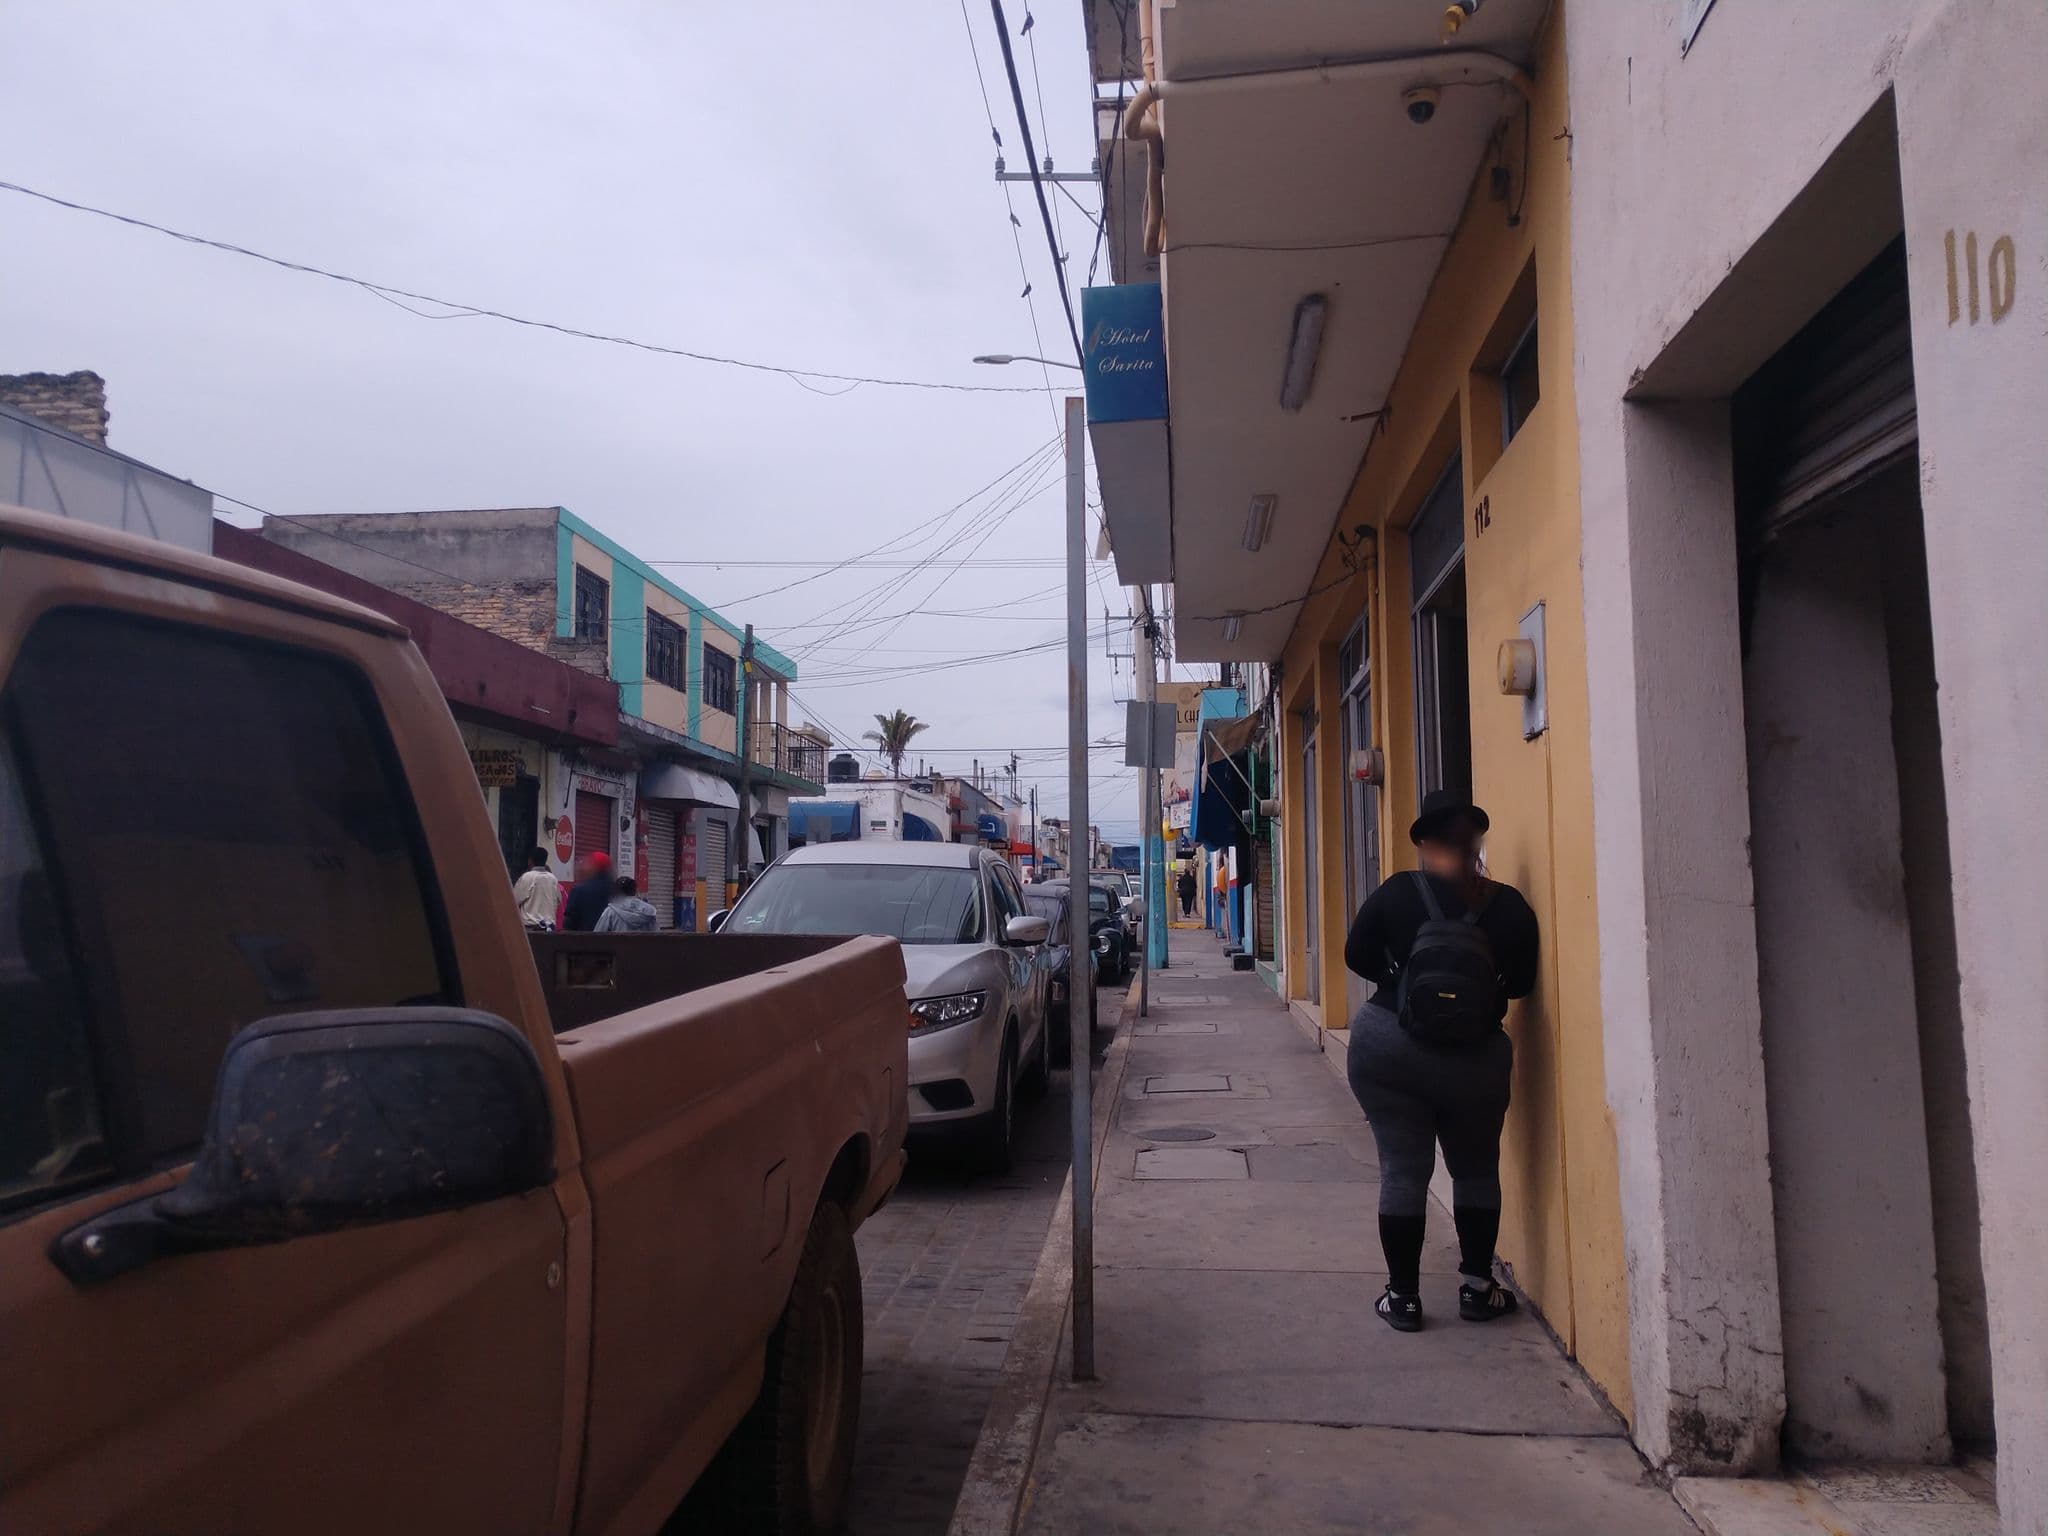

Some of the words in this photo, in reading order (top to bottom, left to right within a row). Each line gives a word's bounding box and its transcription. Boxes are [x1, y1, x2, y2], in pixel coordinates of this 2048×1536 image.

[1944, 228, 2016, 327] 110
[1101, 327, 1151, 345] Hotel
[1099, 355, 1154, 375] Sarita
[1475, 495, 1490, 539] 112
